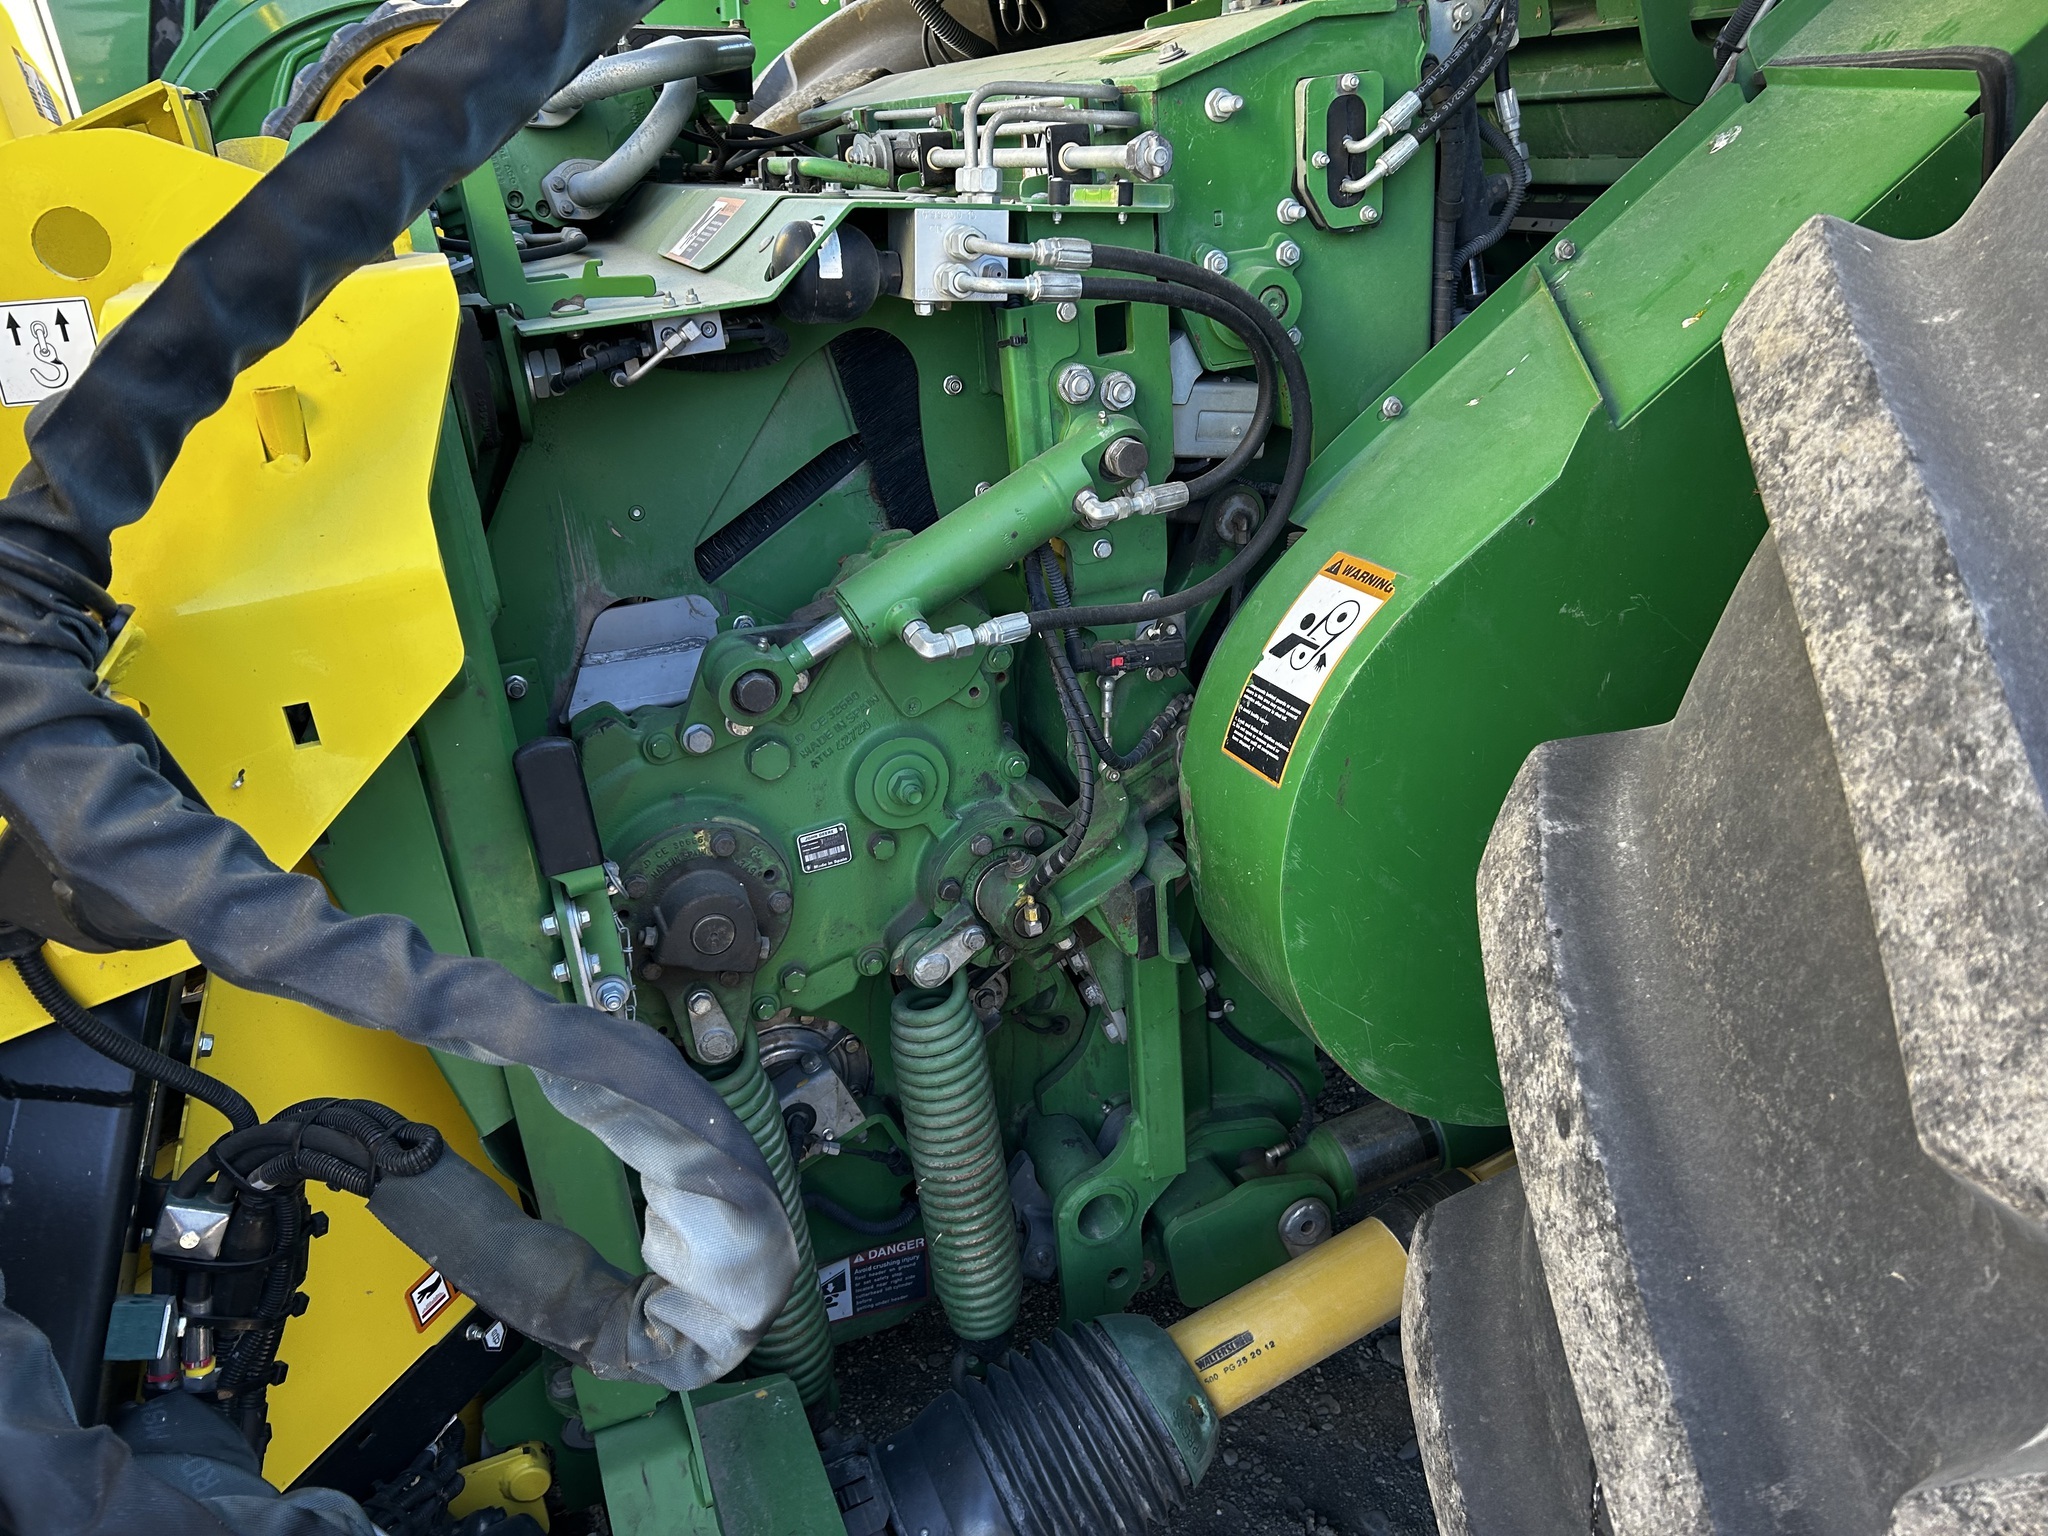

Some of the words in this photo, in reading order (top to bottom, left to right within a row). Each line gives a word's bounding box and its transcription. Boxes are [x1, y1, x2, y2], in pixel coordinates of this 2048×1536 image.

[1342, 564, 1395, 594] WARNING
[799, 729, 834, 759] MADE
[833, 720, 847, 733] IN
[845, 693, 880, 724] SPAIN
[655, 846, 670, 859] CE
[868, 1237, 925, 1260] DANGER
[854, 1265, 872, 1275] Avoid
[873, 1258, 901, 1271] crushing
[902, 1254, 920, 1265] injury
[1223, 1364, 1236, 1374] PG
[1236, 1357, 1248, 1367] 25
[1250, 1348, 1262, 1359] 20
[1264, 1340, 1276, 1350] 12
